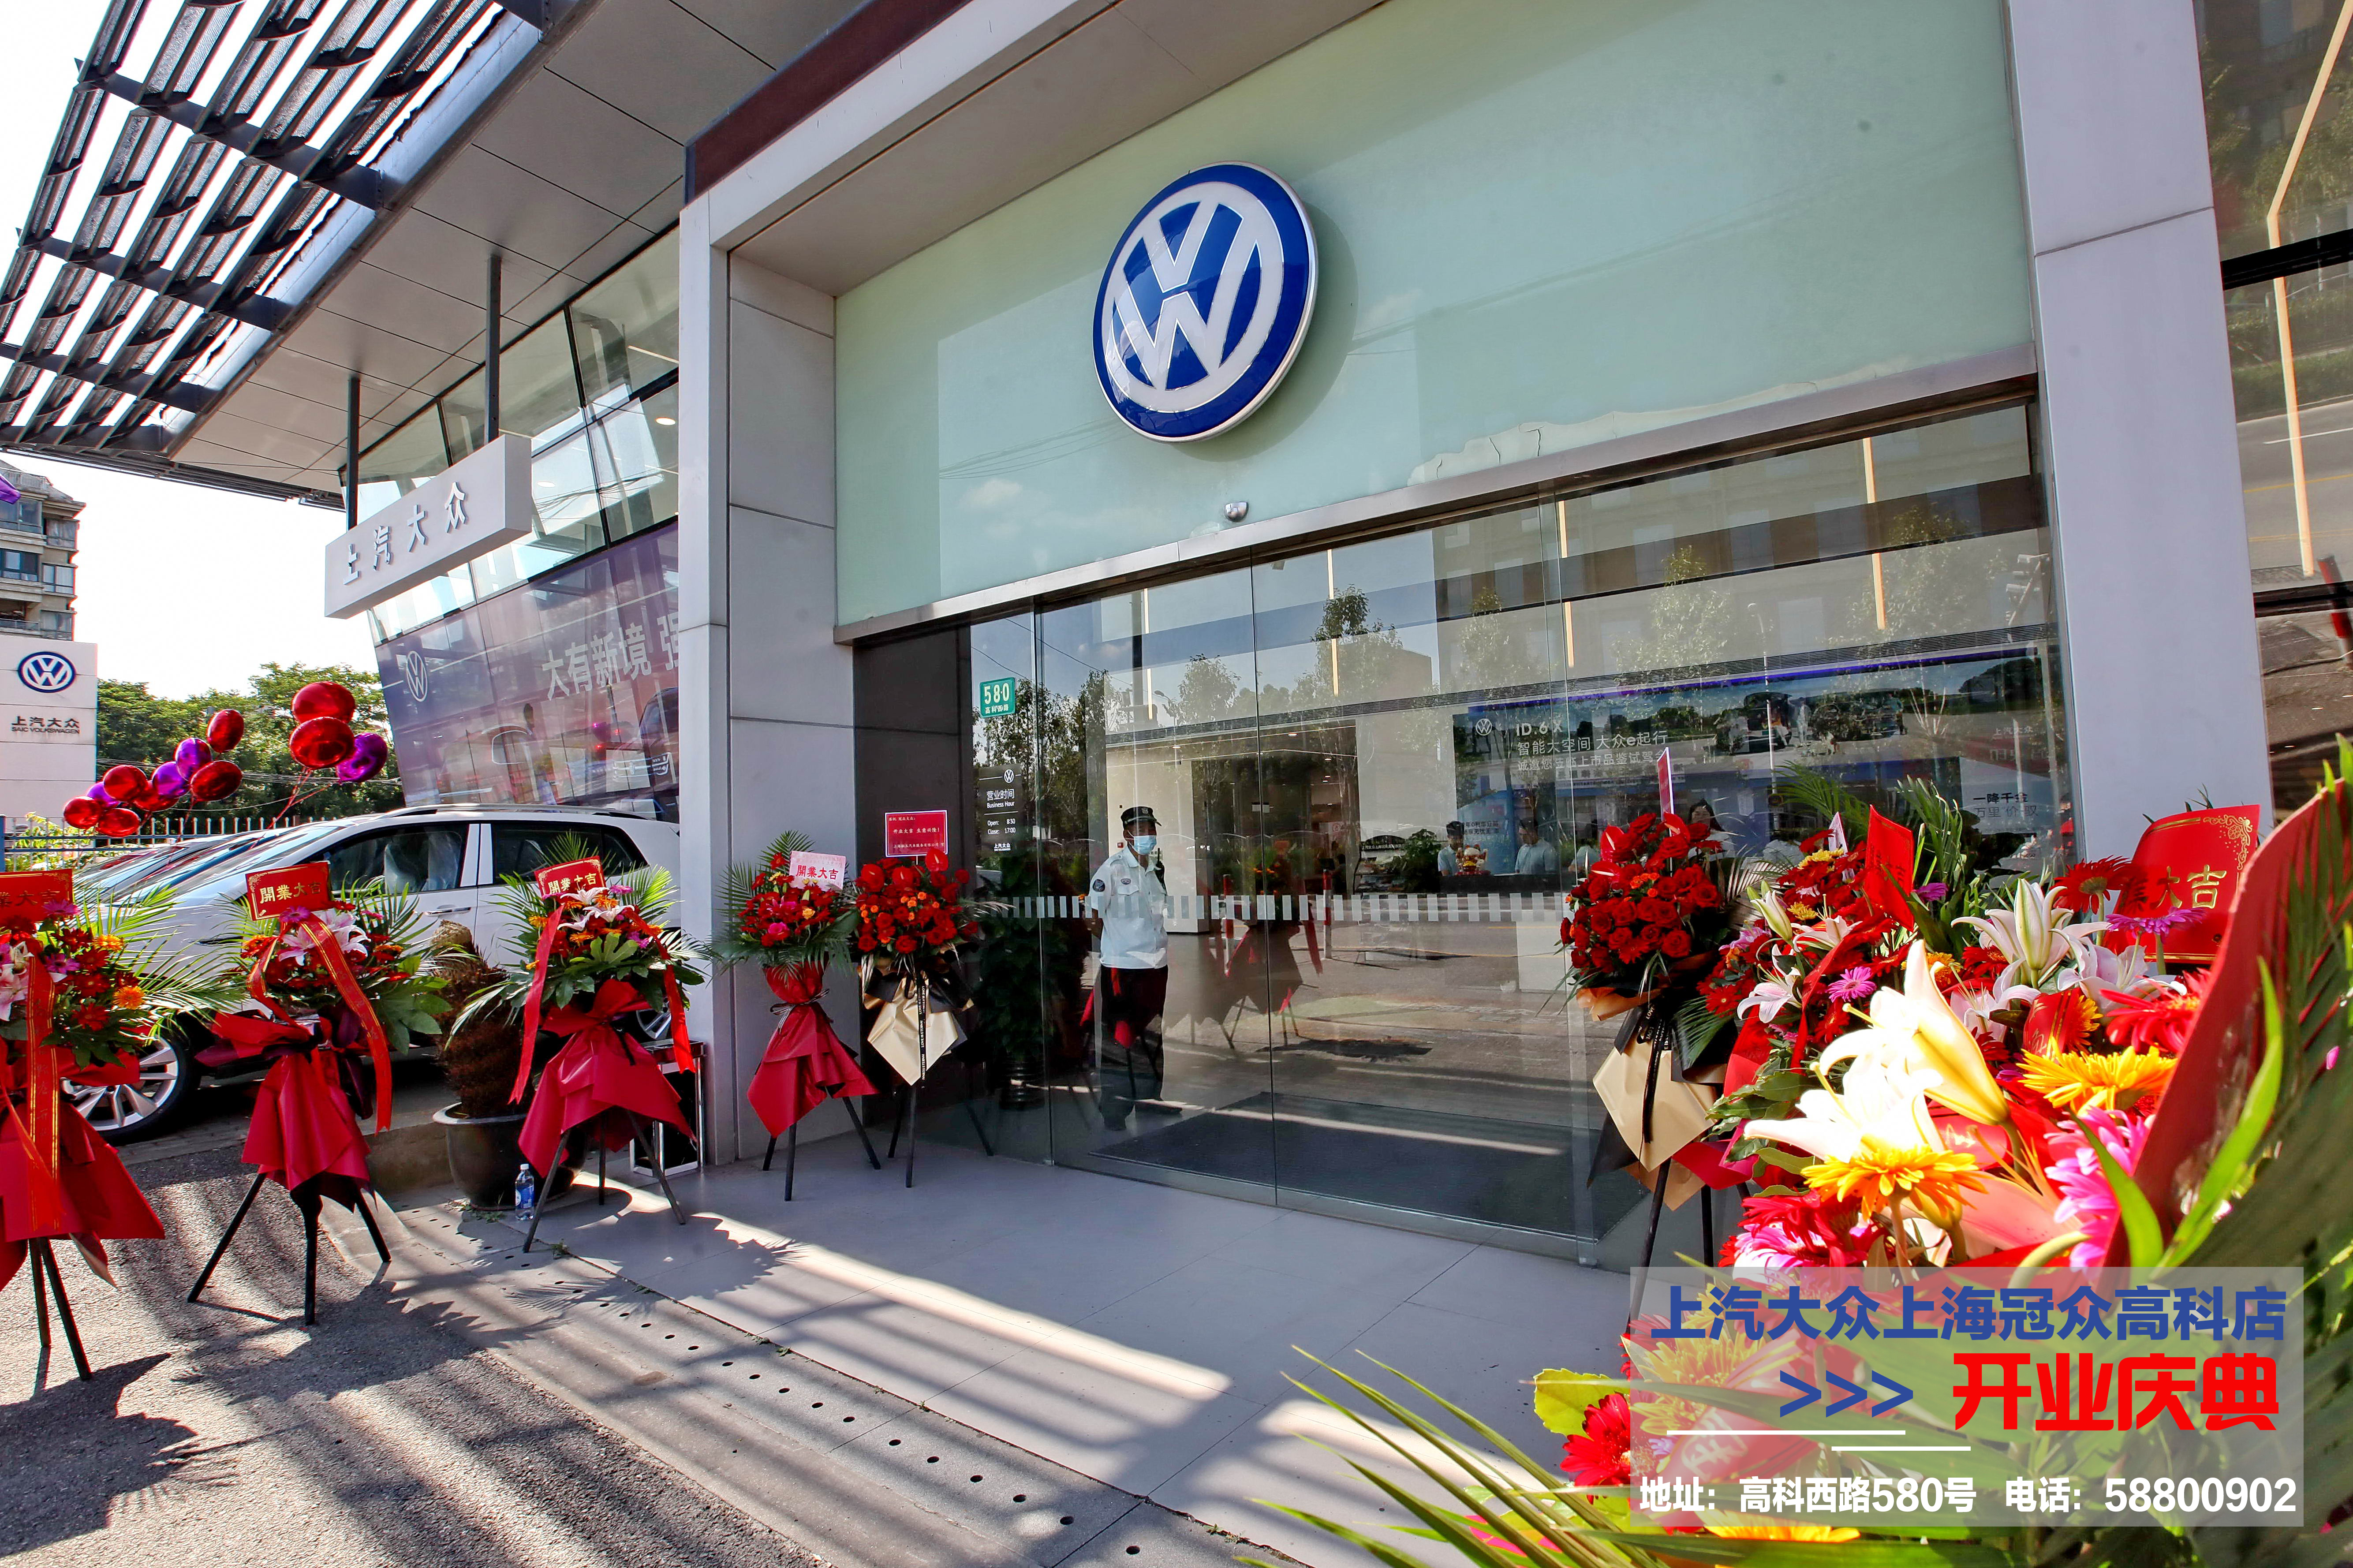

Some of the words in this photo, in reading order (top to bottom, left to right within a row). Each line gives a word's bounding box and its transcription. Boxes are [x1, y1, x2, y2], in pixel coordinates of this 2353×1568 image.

[342, 482, 467, 586] 上汽大众
[542, 623, 652, 701] 大有新境
[984, 683, 1009, 705] 580
[985, 704, 1009, 714] 高科西路
[11, 716, 80, 728] 上汽大众
[1517, 737, 1591, 756] 智能大空间
[1596, 730, 1668, 750] 大众e起行
[986, 788, 1015, 801] 营业时间
[795, 865, 839, 880] 開業大吉
[259, 881, 321, 904] 開業大吉
